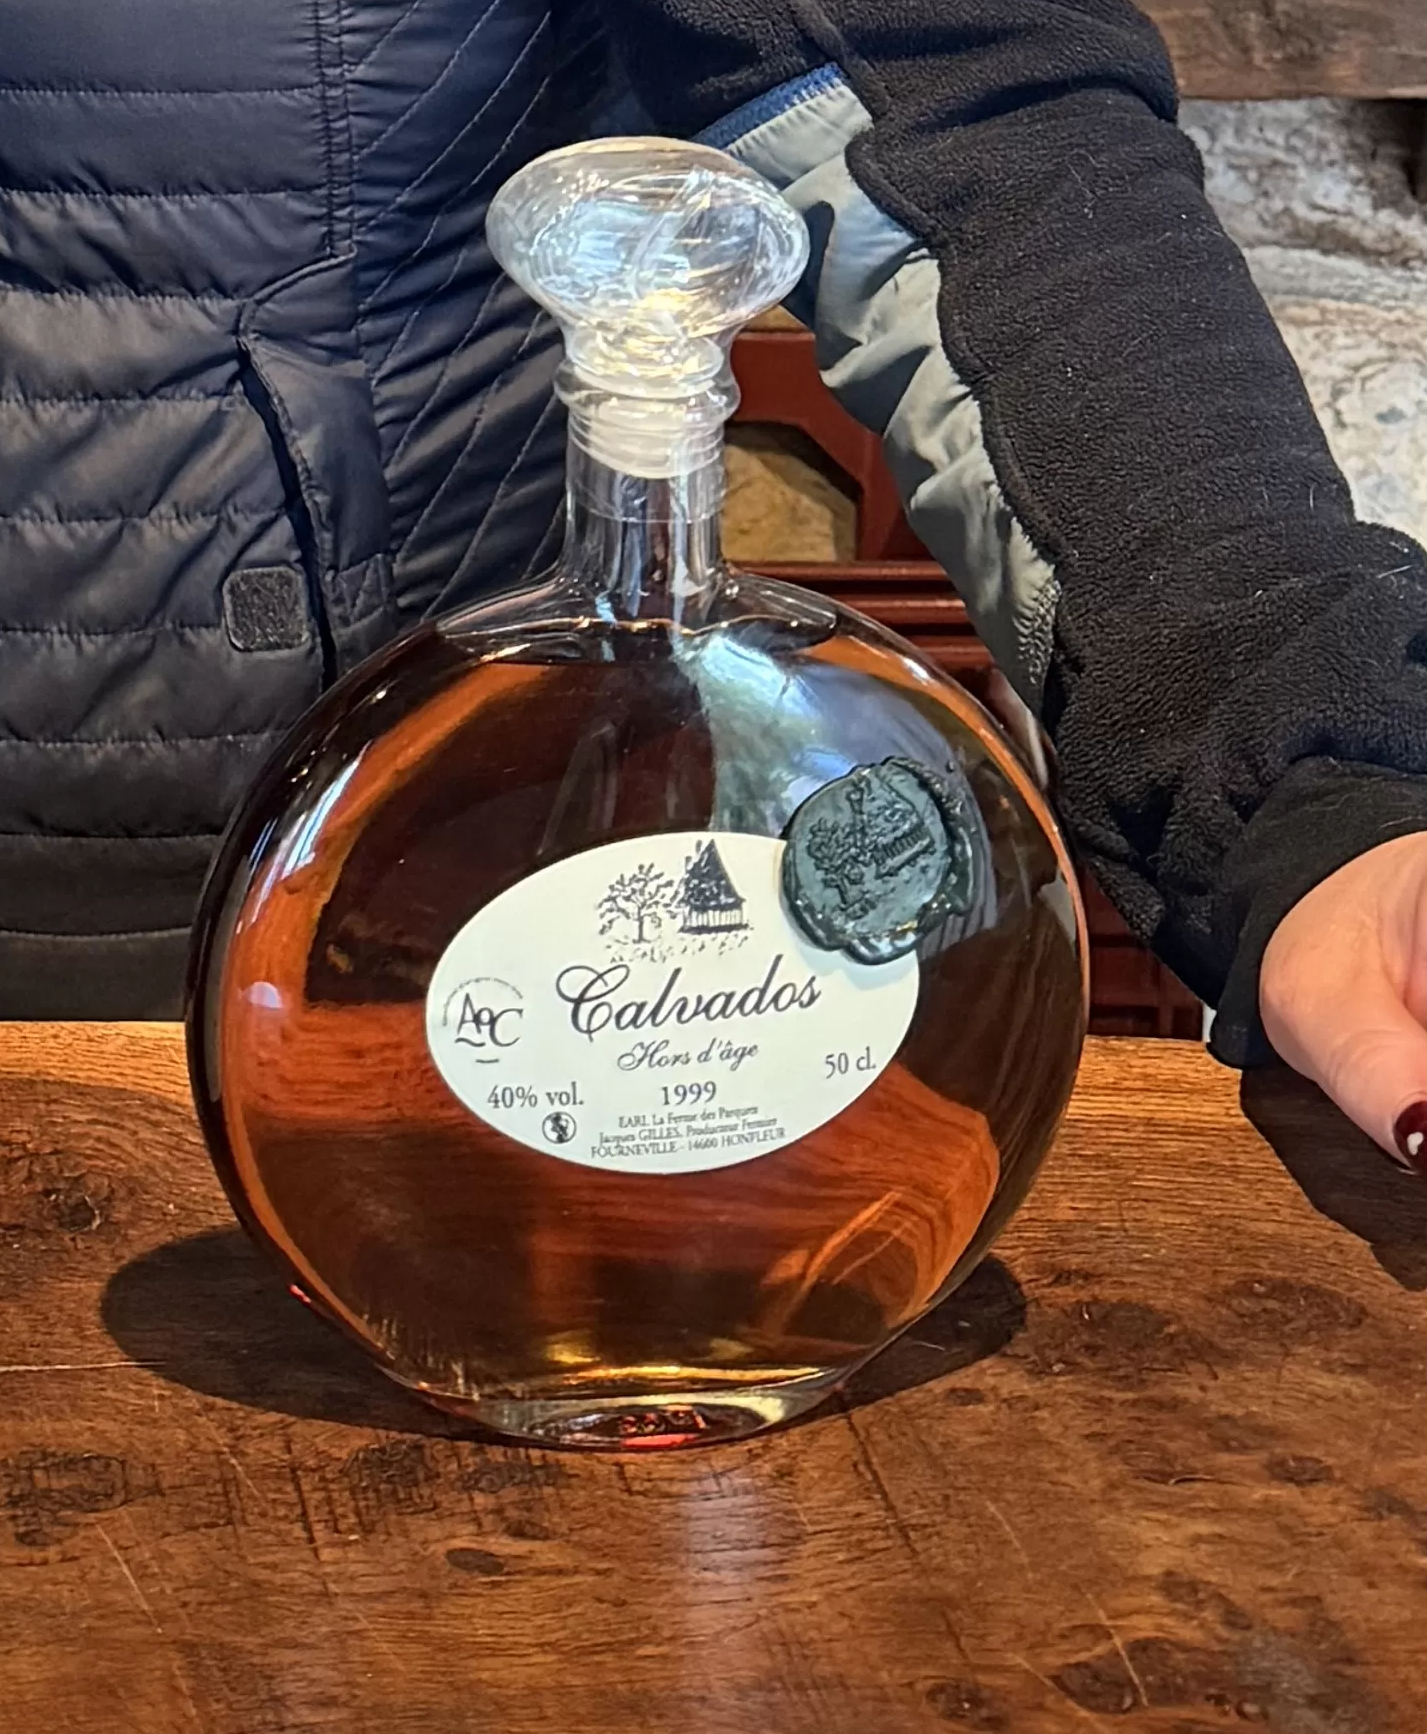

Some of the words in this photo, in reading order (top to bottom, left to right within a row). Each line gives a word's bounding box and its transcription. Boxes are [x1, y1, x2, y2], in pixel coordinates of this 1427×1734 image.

[555, 952, 823, 1044] Calvados
[616, 1039, 692, 1073] Hors
[696, 1037, 760, 1066] d'âge
[824, 1052, 852, 1078] 50
[486, 1084, 539, 1109] 40%
[545, 1080, 586, 1106] vol.
[660, 1080, 718, 1107] 1999
[651, 1113, 665, 1126] La
[666, 1111, 697, 1125] Ferme
[699, 1107, 717, 1121] des
[590, 1140, 678, 1159] FOURNEVILLE
[720, 1126, 787, 1148] HONFLEUR
[598, 1131, 637, 1146] Jacques
